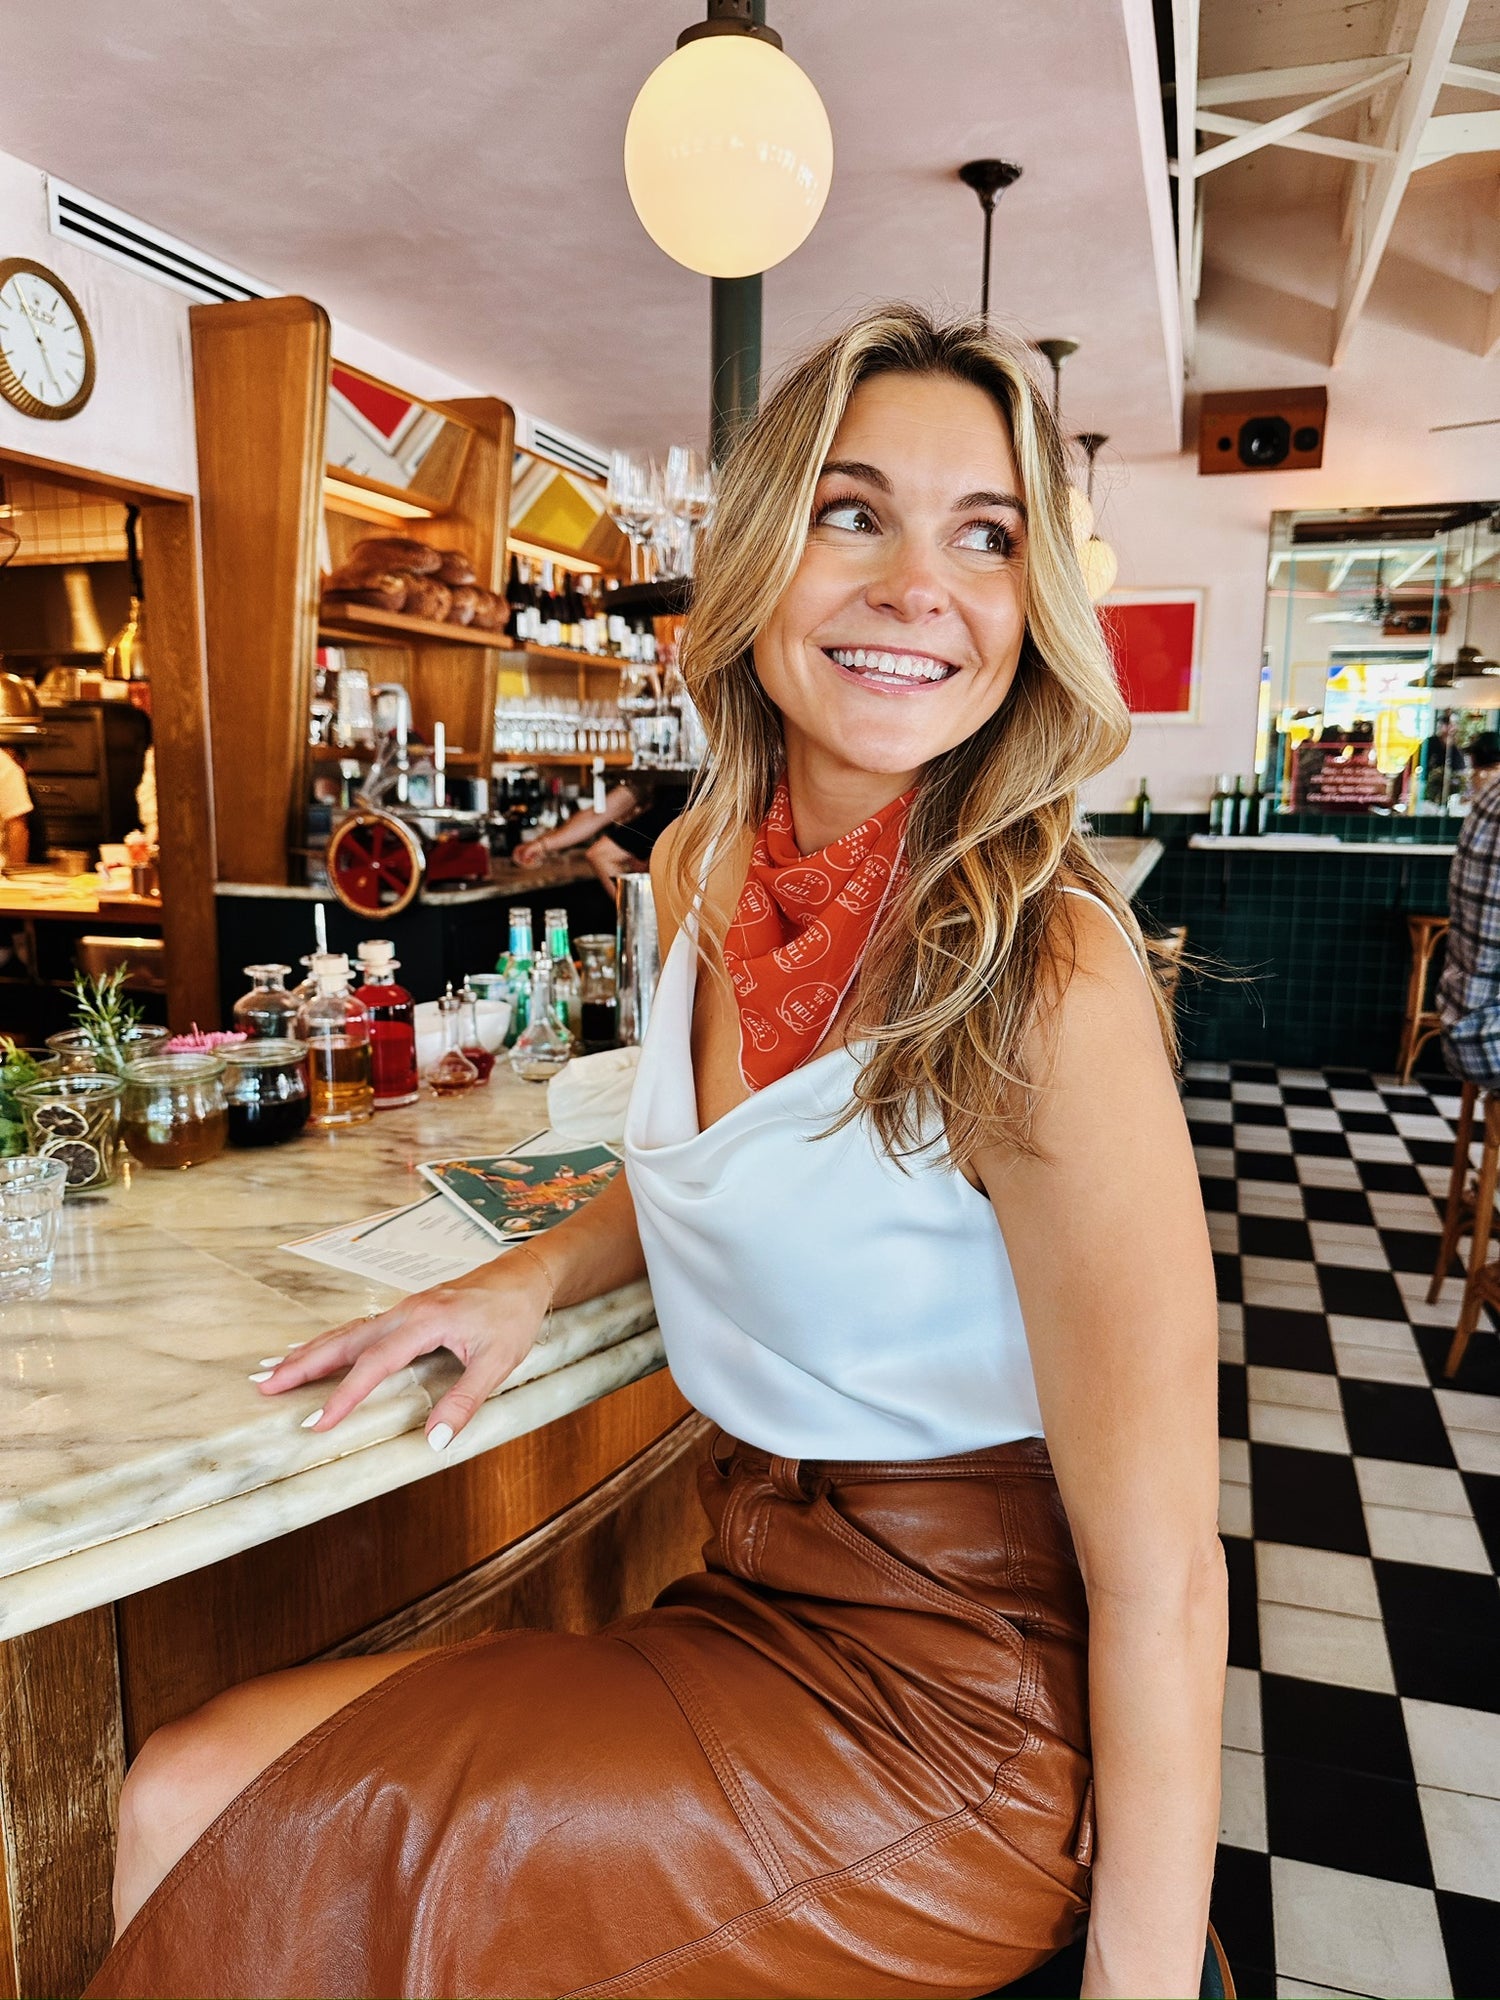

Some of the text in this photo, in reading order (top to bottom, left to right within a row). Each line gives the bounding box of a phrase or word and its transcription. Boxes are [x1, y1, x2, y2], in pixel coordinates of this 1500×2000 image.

[865, 860, 887, 877] GIVE
[783, 883, 811, 898] HELL
[816, 987, 835, 1002] GIVE
[789, 1000, 815, 1025] HELL
